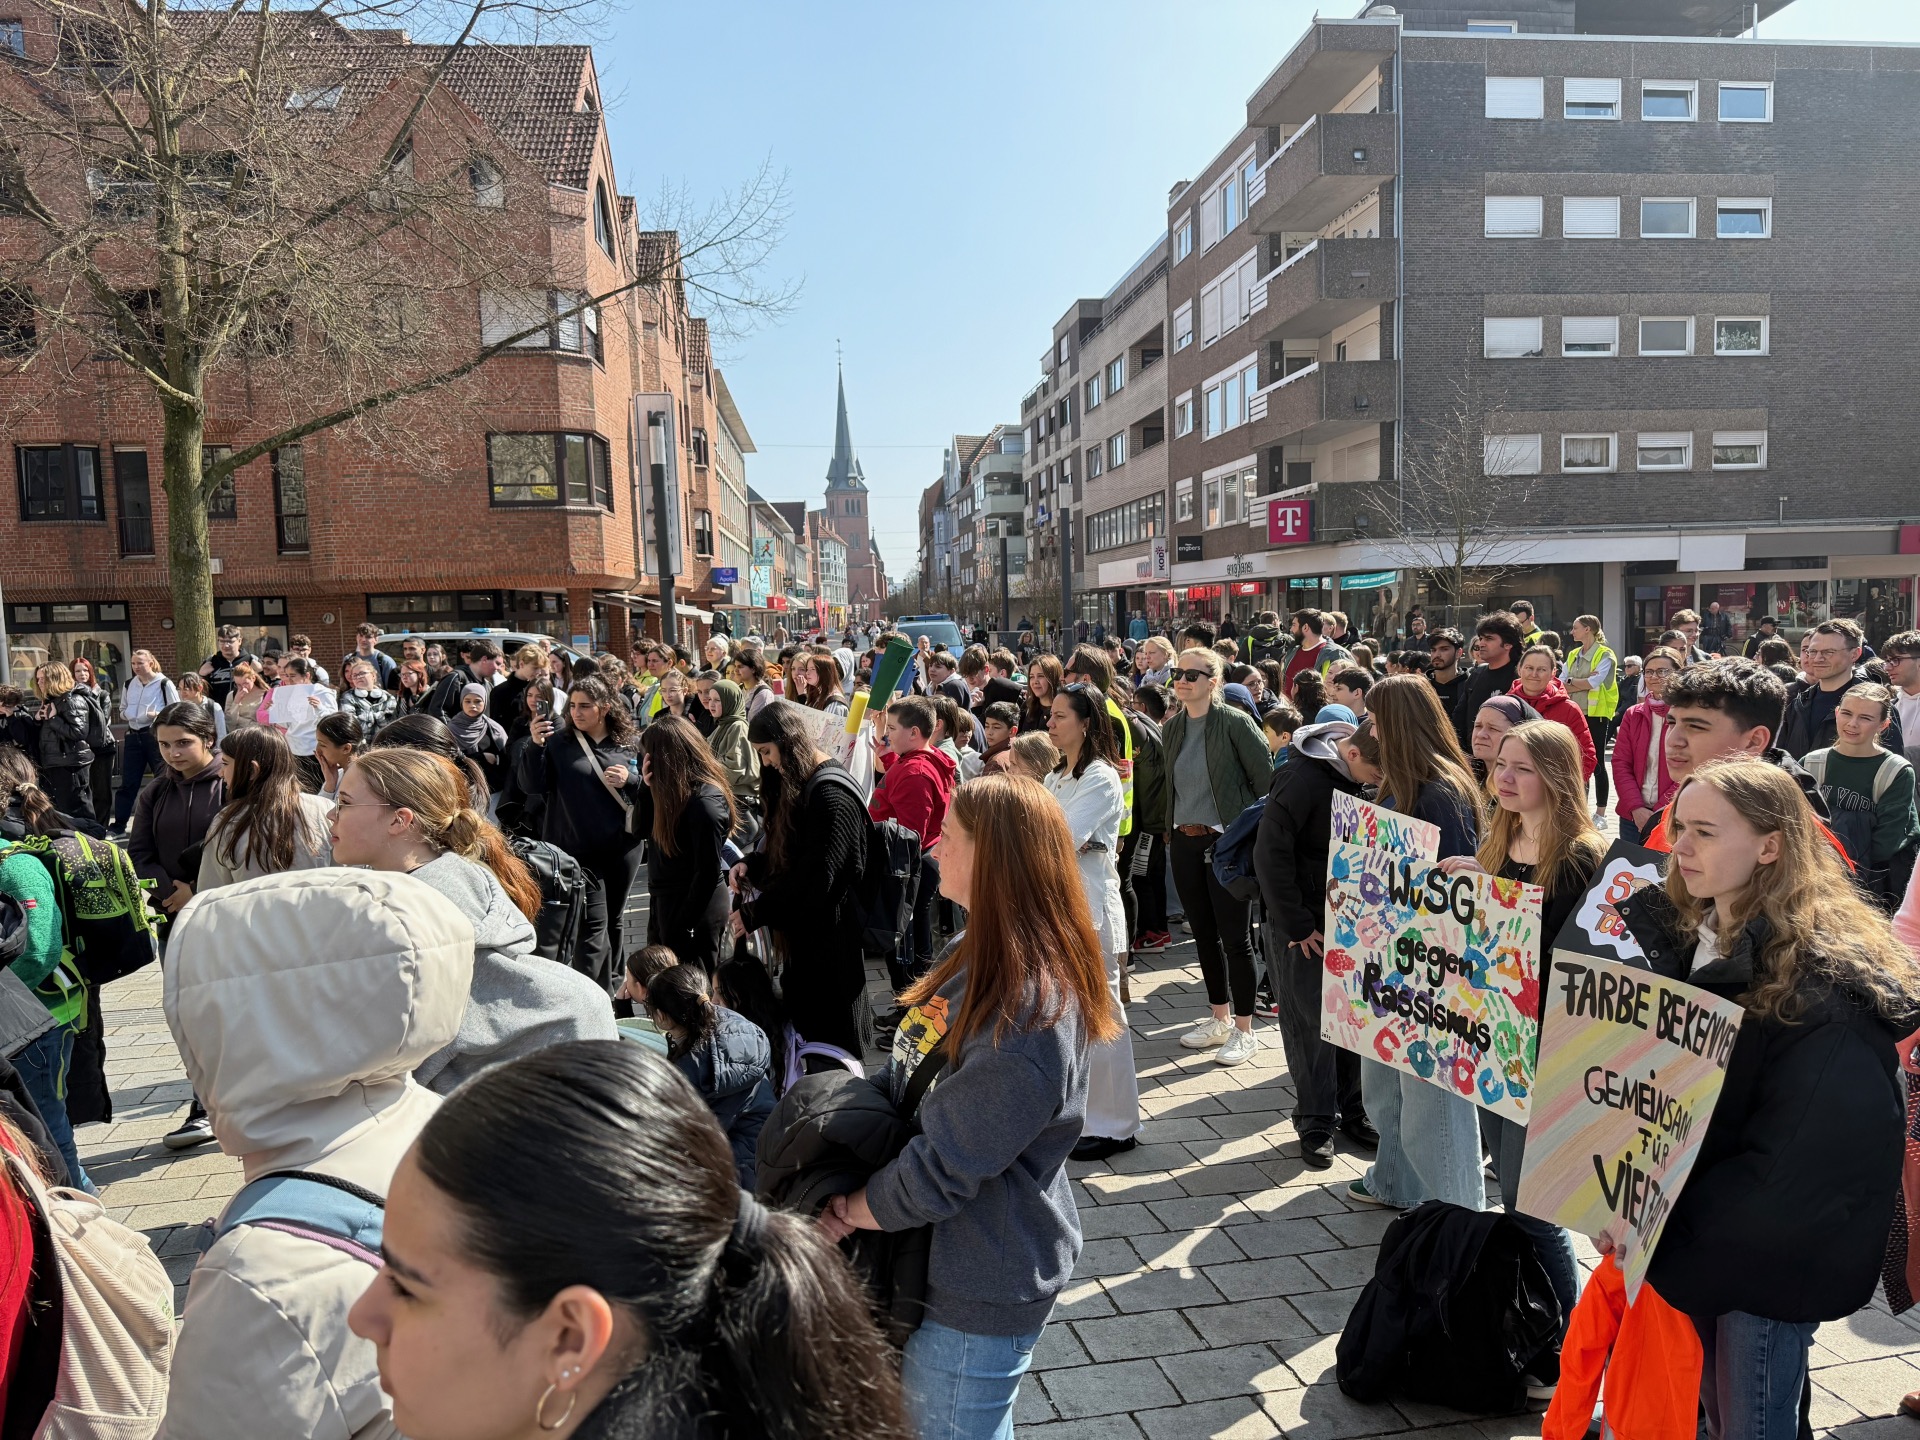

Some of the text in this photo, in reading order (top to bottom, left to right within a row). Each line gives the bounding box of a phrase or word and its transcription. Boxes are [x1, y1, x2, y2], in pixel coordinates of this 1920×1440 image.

[1277, 507, 1302, 536] T
[1396, 937, 1474, 988] gegen
[1362, 962, 1492, 1053] Rassismus
[1554, 961, 1651, 1030] FARBE
